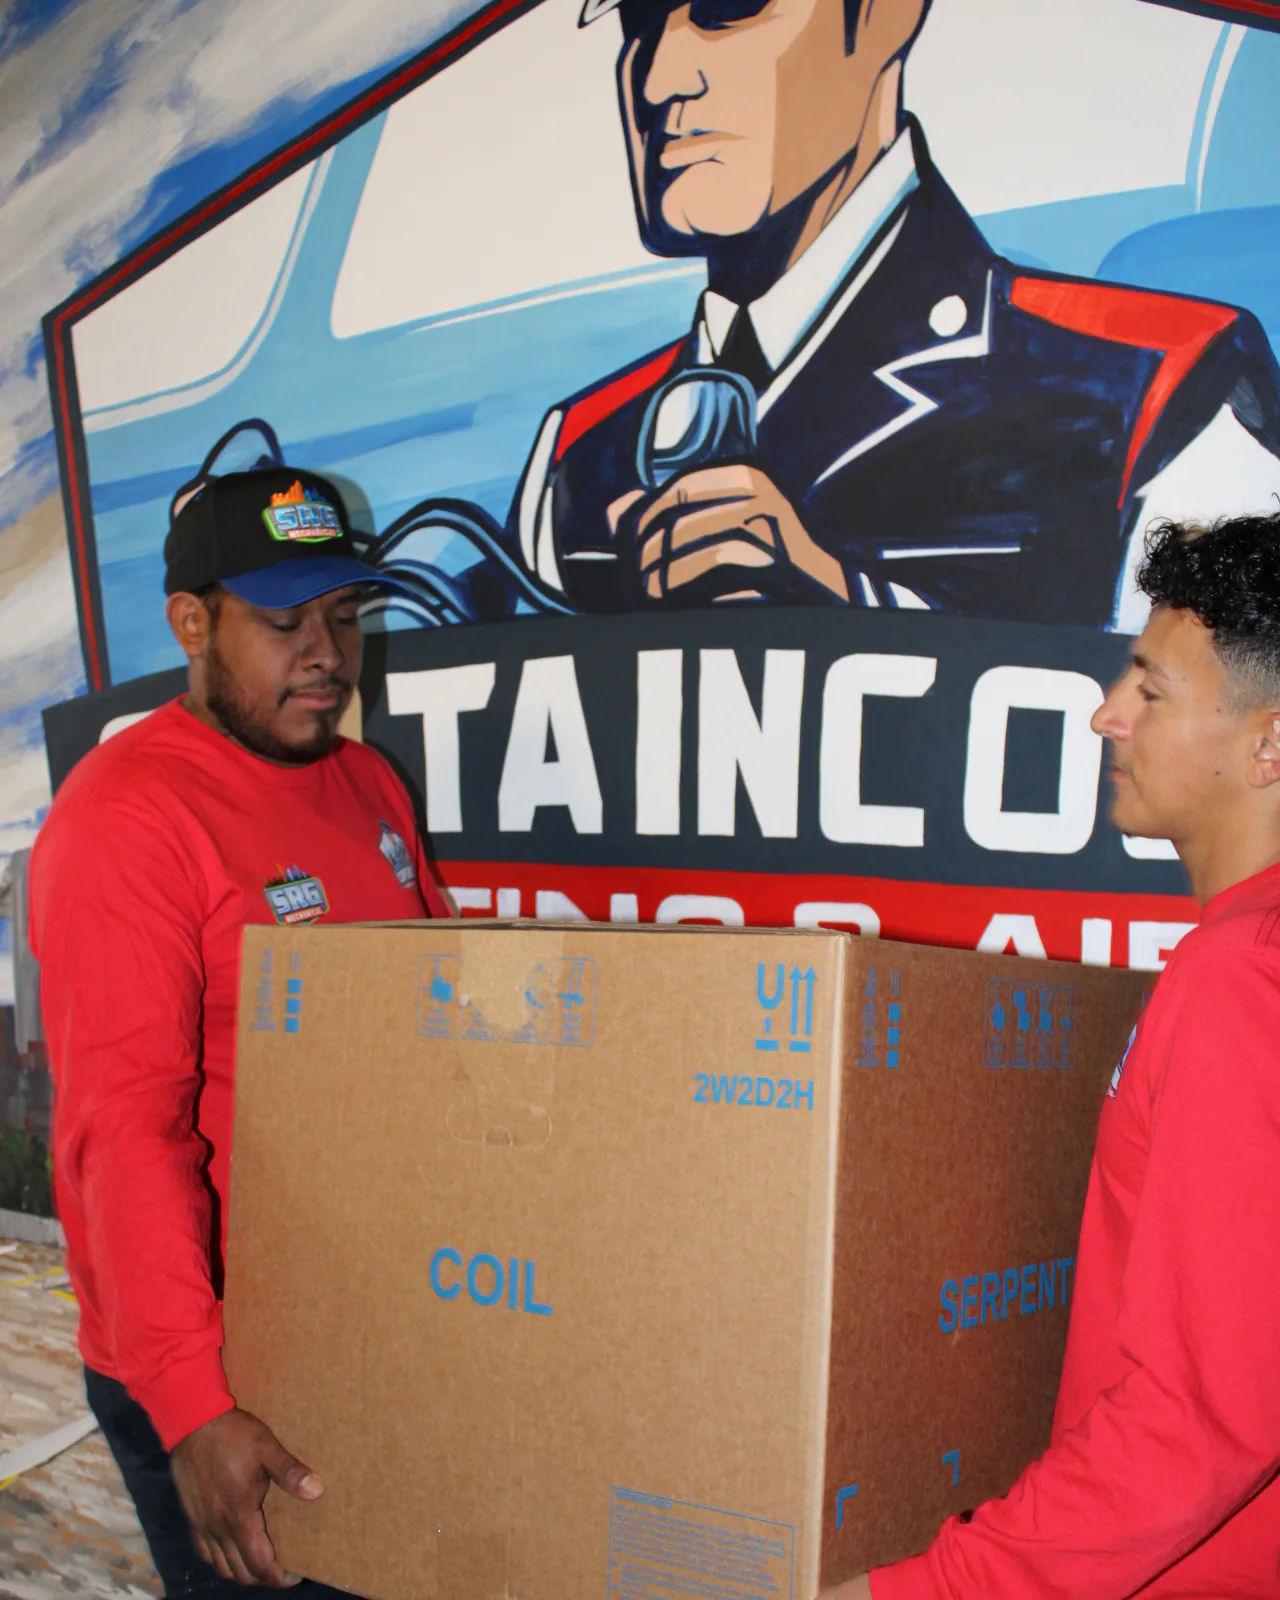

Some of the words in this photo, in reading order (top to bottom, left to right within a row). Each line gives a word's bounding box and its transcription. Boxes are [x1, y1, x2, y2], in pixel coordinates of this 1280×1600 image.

[694, 1074, 814, 1111] 2W2D2H
[430, 1248, 552, 1315] COIL
[939, 1257, 1076, 1333] SERPENT
